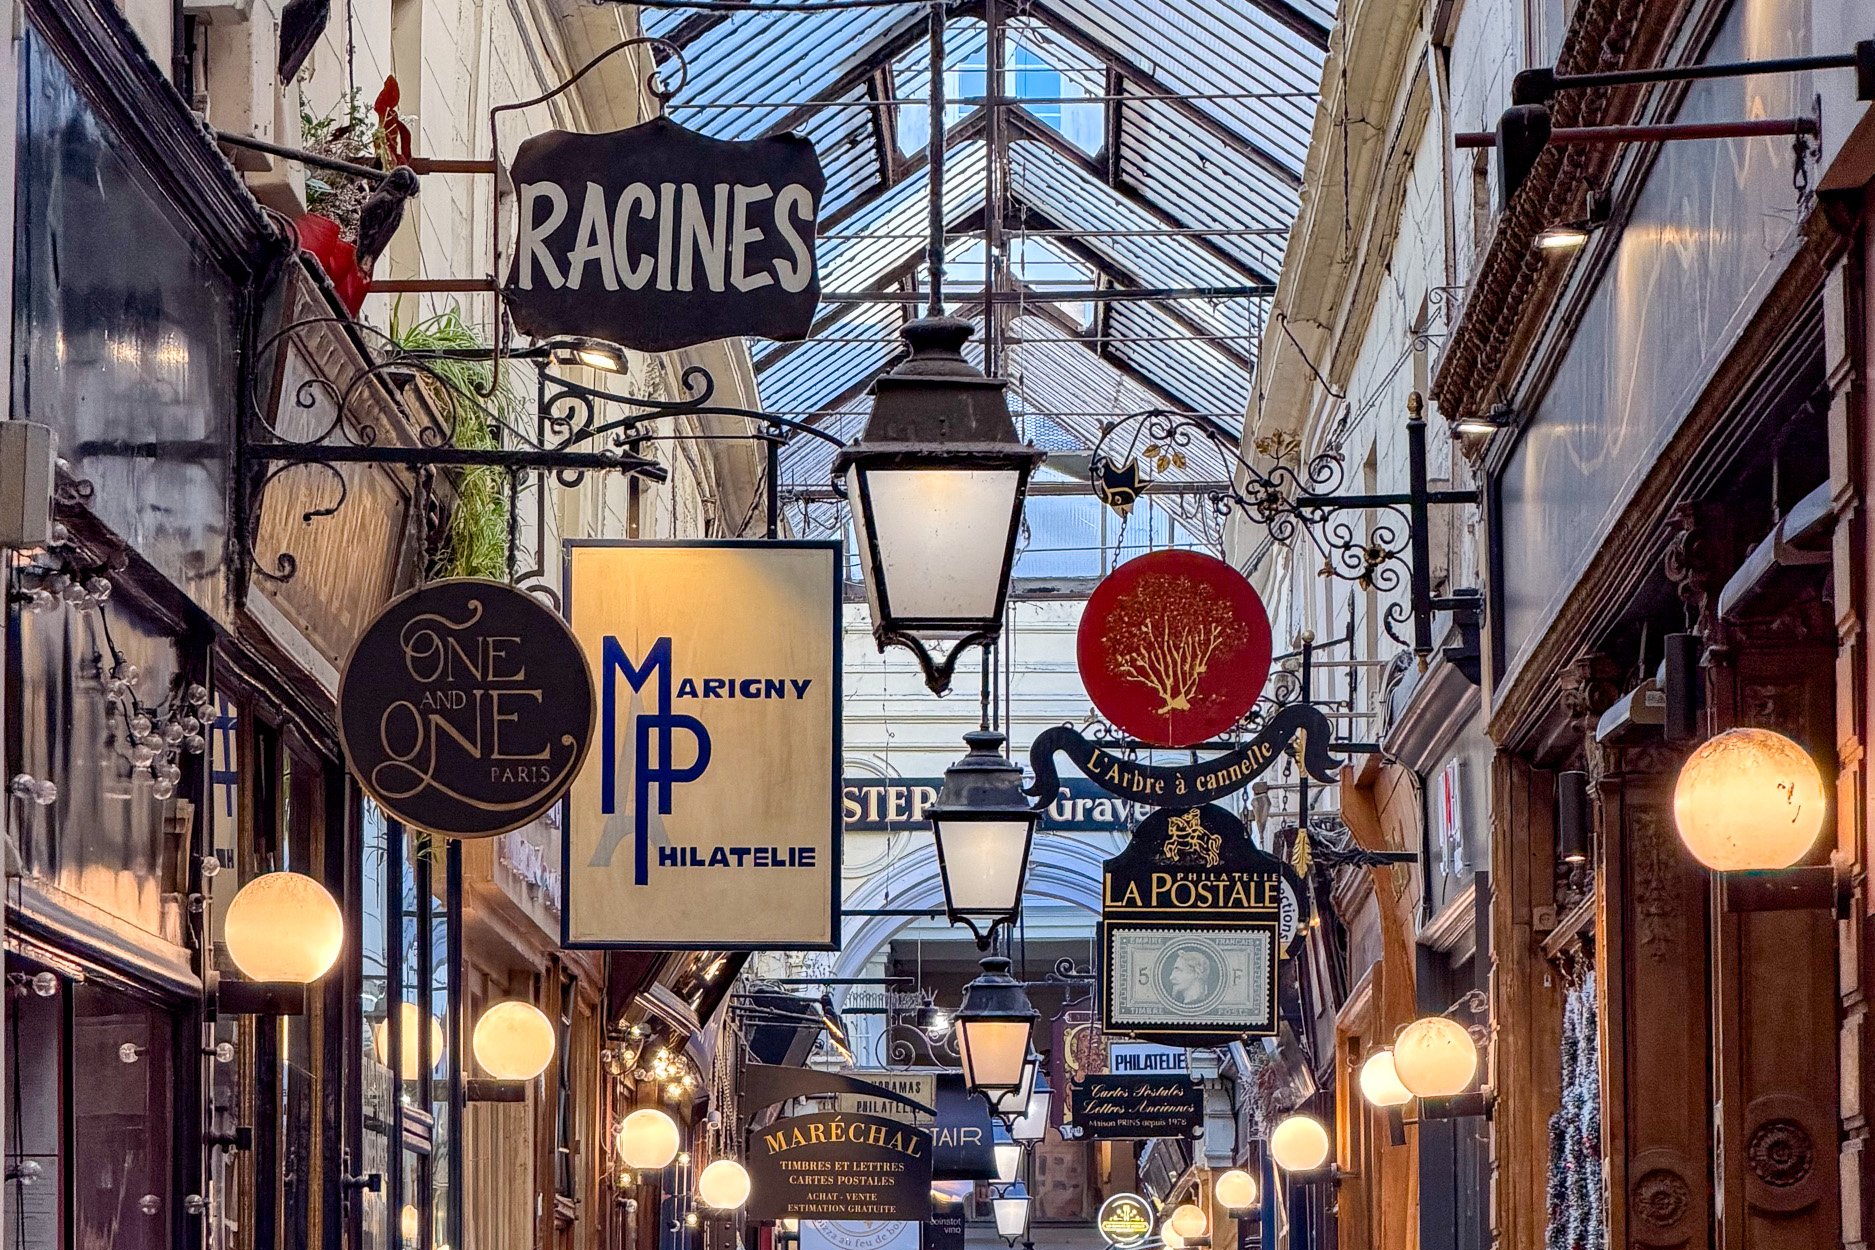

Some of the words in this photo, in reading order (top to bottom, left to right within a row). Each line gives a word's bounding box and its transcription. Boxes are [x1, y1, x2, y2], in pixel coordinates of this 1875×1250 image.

[518, 182, 814, 293] RACINES
[400, 608, 525, 684] ONE
[420, 690, 466, 711] AND
[374, 689, 553, 798] ONE
[490, 766, 551, 784] PARIS
[1086, 748, 1164, 795] L'Arbre
[1175, 773, 1187, 795] à
[1196, 741, 1273, 792] cannelle
[842, 786, 942, 823] STER
[1051, 786, 1156, 823] Grave
[1176, 872, 1279, 881] PHILATELIE
[1105, 872, 1143, 907] LA
[1151, 872, 1279, 908] POSTALE
[1138, 967, 1150, 986] 5
[1231, 968, 1243, 986] F
[1091, 1083, 1129, 1098] Cartes
[1132, 1083, 1184, 1098] Postales
[1081, 1100, 1125, 1114] Lettres
[1128, 1099, 1195, 1113] Anciennes
[764, 1117, 921, 1157] MARÉCHAL
[919, 1127, 983, 1148] TAIR
[780, 1161, 832, 1171] TIMBRES
[835, 1162, 850, 1171] ET
[853, 1162, 905, 1172] LETTRES
[789, 1175, 834, 1185] CARTES
[838, 1176, 895, 1186] POSTALES
[807, 1192, 839, 1201] ACHAT
[846, 1193, 877, 1201] VENTE
[788, 1203, 846, 1213] ESTIMATION
[848, 1204, 897, 1214] GRATUITE
